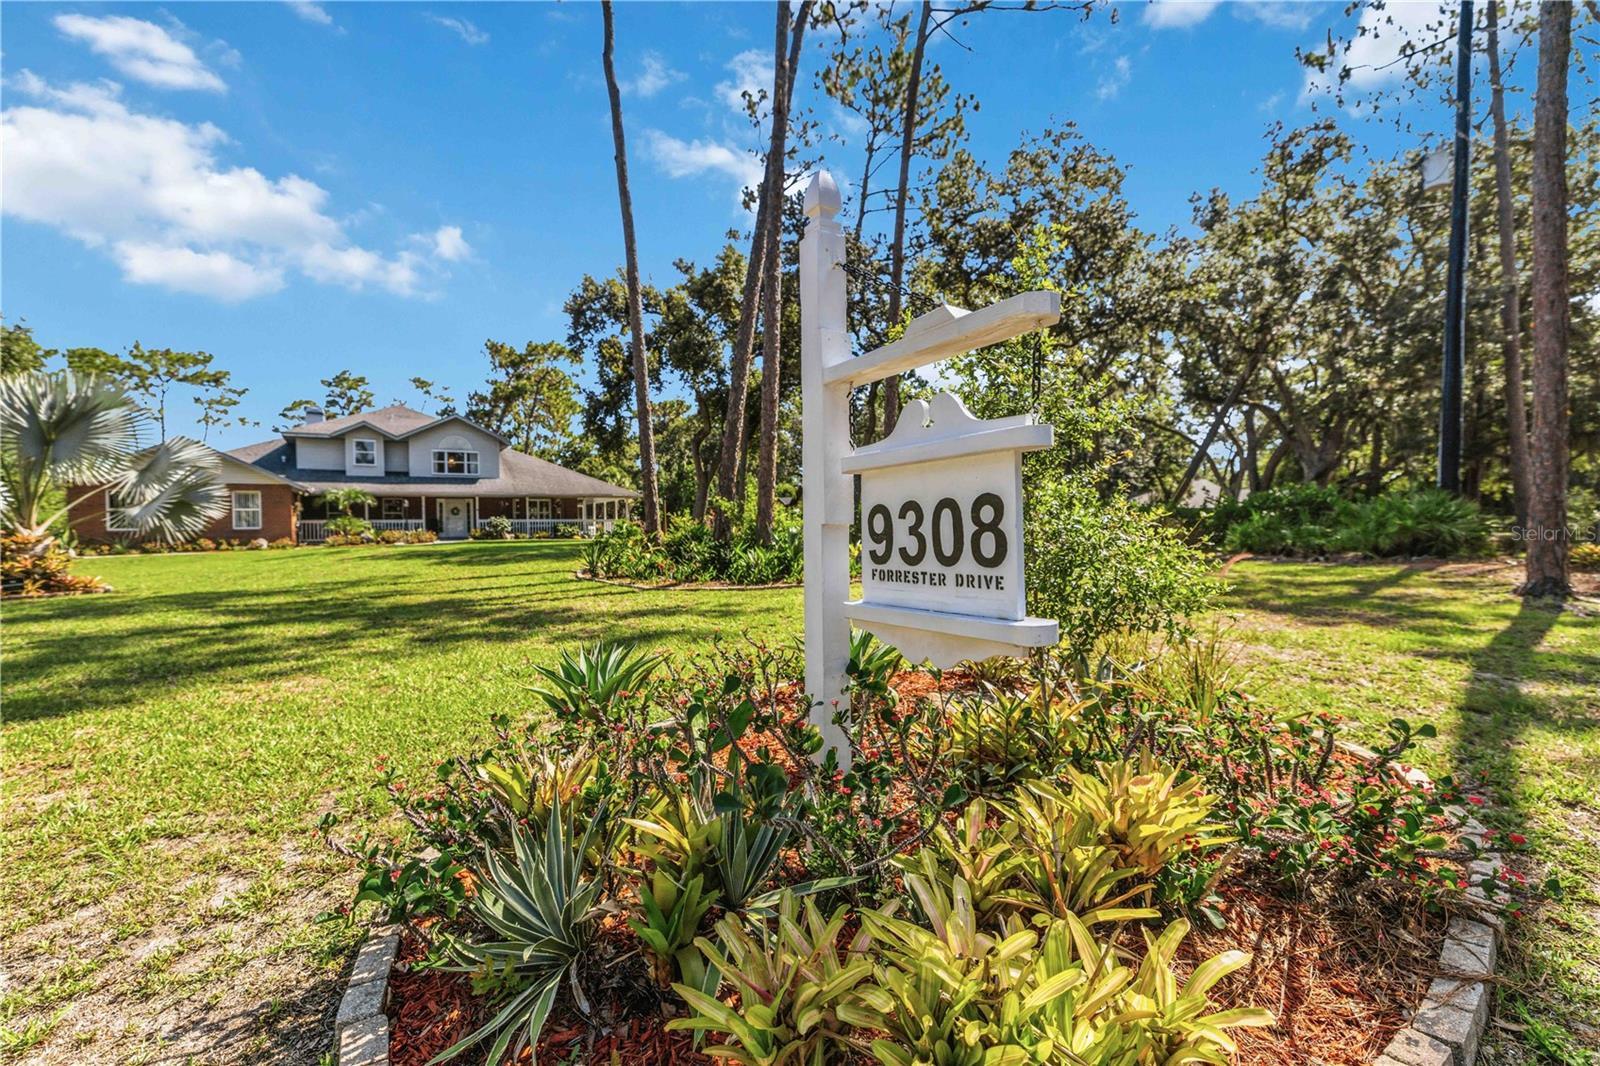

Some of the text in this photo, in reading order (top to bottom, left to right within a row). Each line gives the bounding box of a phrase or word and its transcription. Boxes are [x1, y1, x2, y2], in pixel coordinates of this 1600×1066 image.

[867, 492, 1008, 568] 9308
[871, 568, 1005, 591] FORRESTER DRIVE
